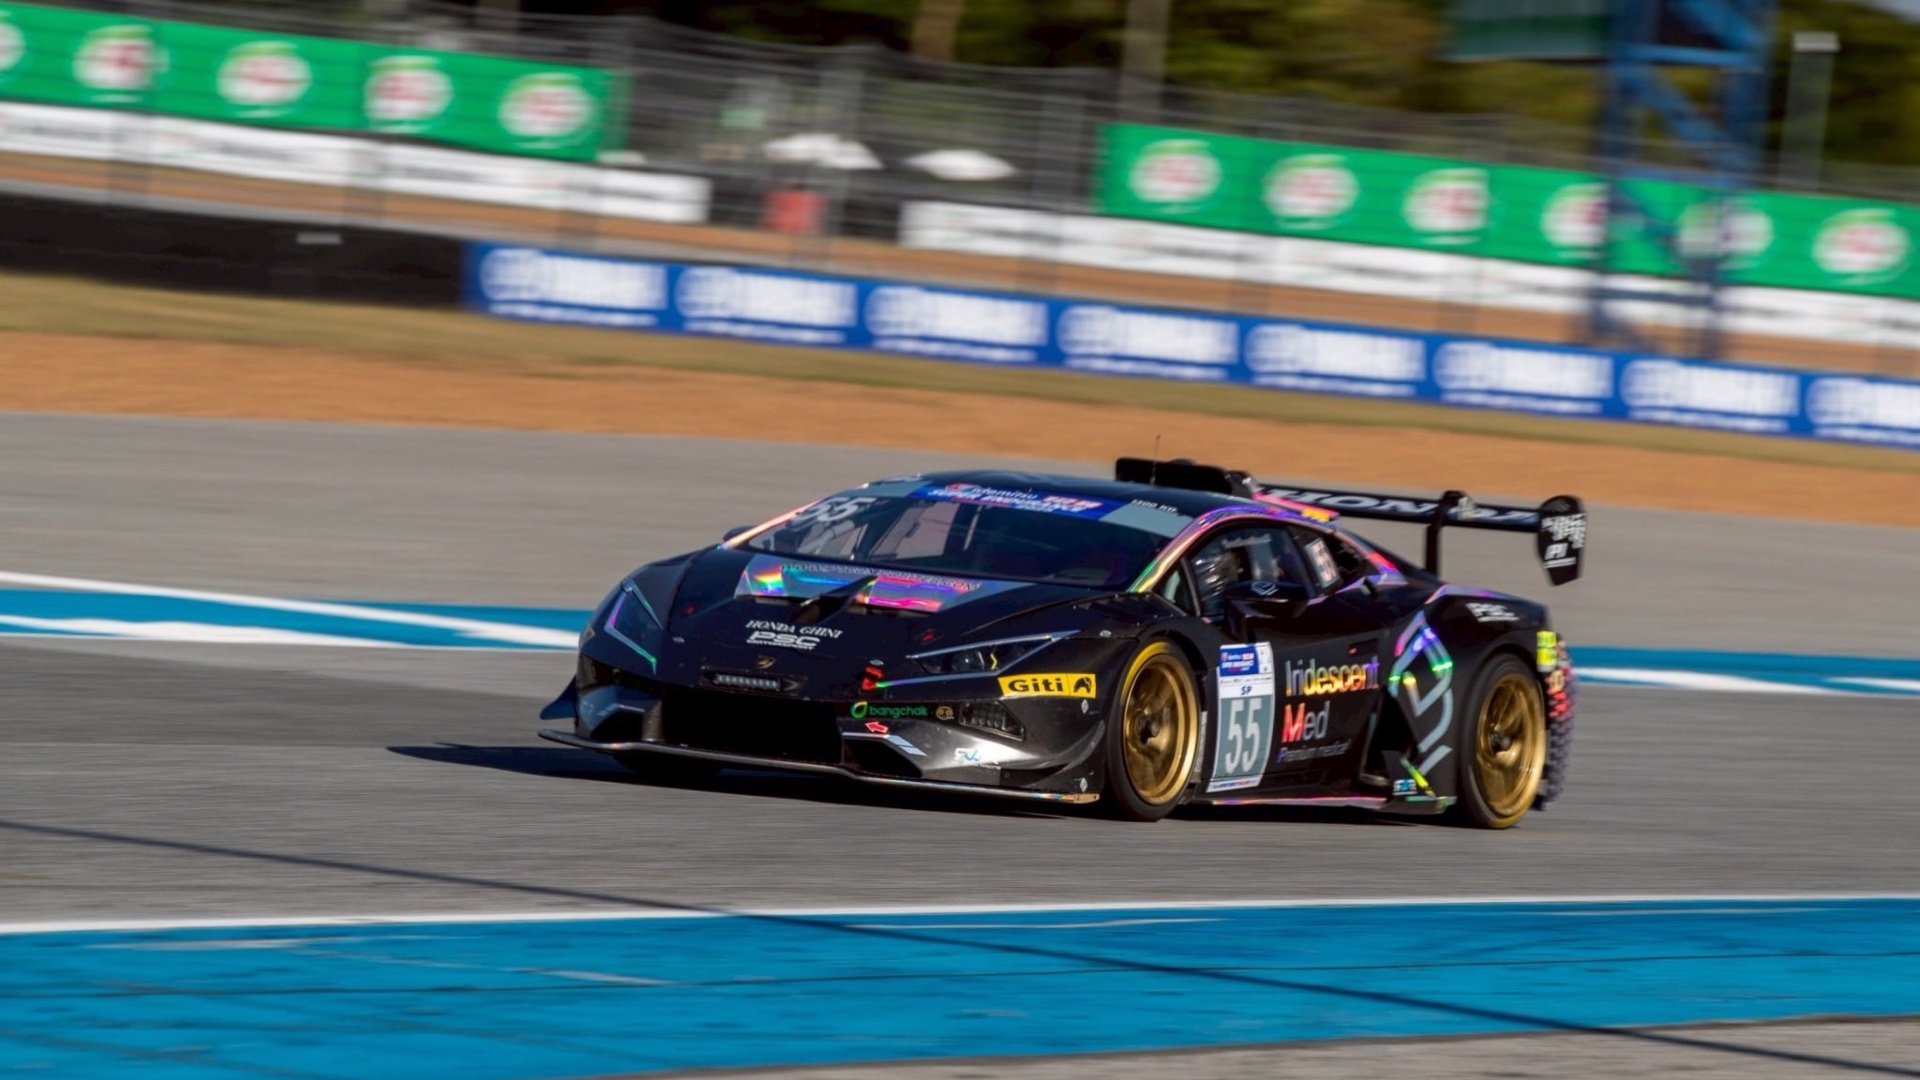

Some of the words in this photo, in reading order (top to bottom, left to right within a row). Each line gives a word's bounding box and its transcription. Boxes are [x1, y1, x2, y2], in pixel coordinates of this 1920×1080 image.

[745, 619, 795, 633] HONDA
[799, 626, 843, 639] GHINI
[749, 630, 821, 647] PSC
[1008, 677, 1064, 692] Giti
[1285, 655, 1380, 697] Iridescent
[869, 705, 928, 719] bangchak
[1281, 700, 1330, 743] Med
[1225, 697, 1262, 774] 55
